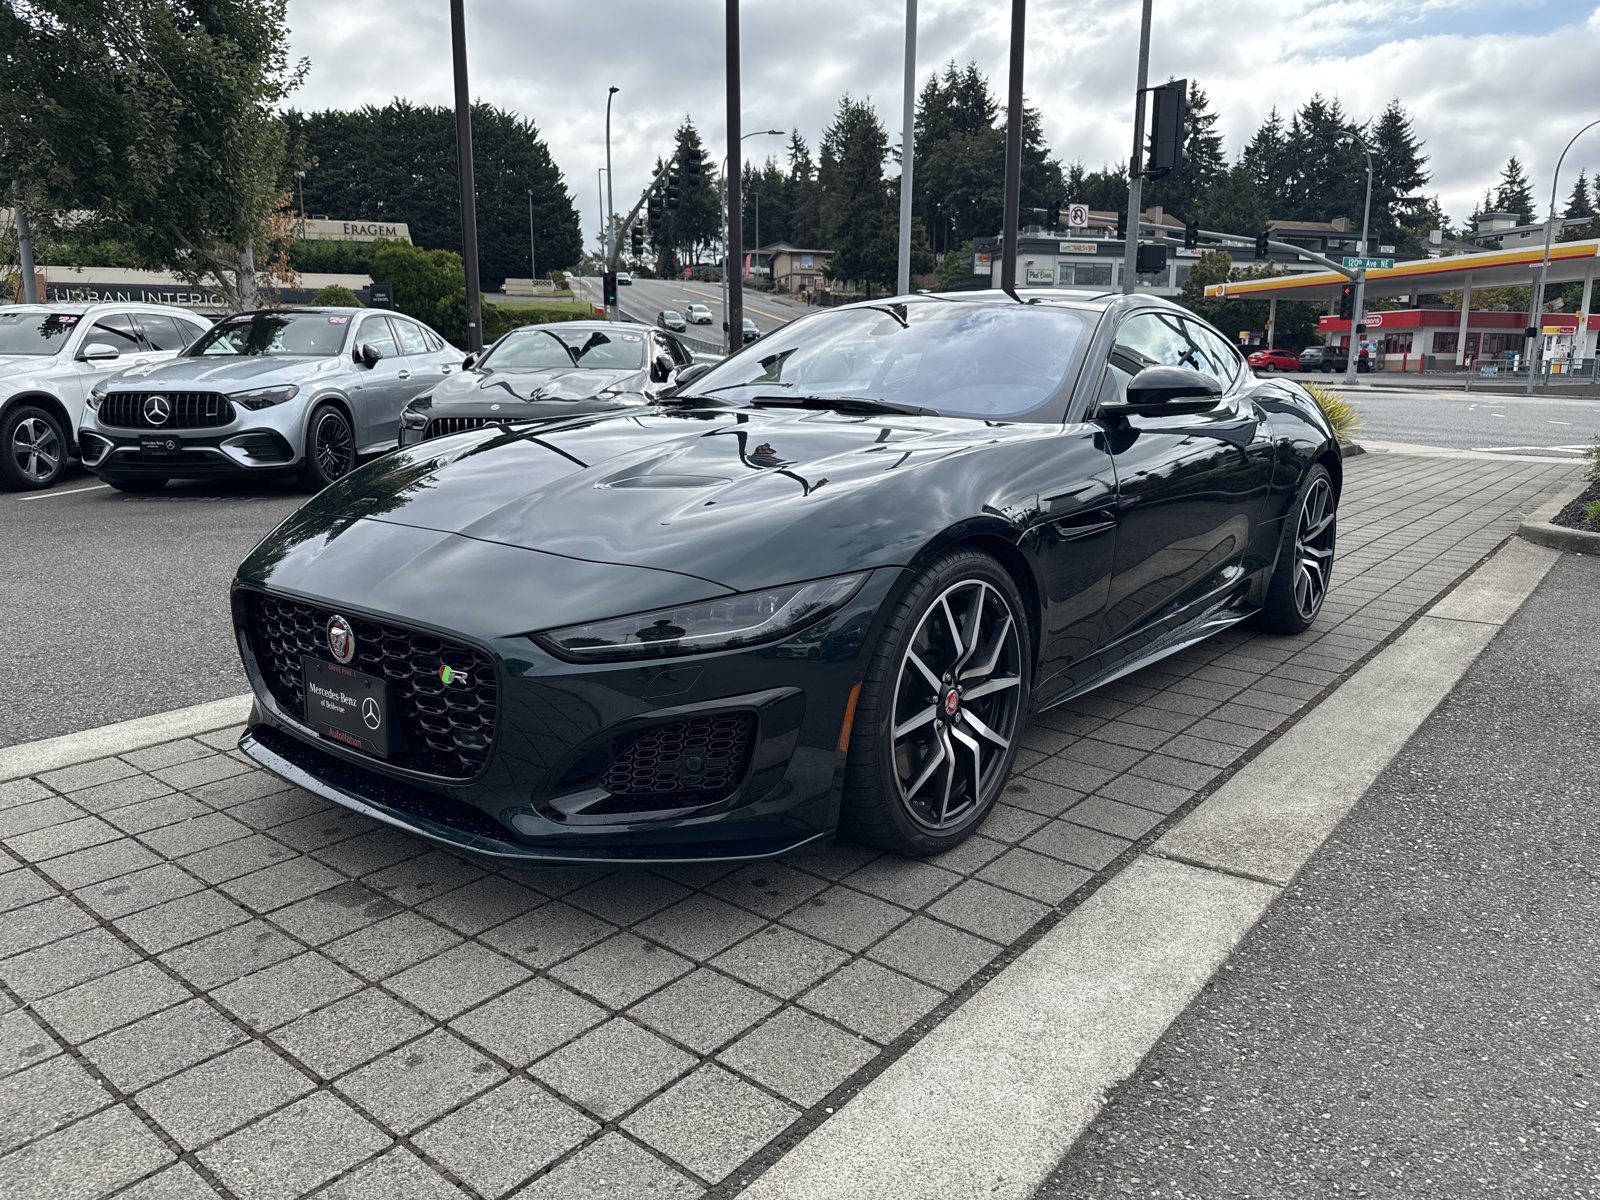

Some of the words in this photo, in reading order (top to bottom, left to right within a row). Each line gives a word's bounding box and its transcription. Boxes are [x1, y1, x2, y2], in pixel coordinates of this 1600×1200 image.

[1348, 258, 1363, 267] 120th
[1365, 259, 1378, 268] Ave
[1380, 260, 1389, 268] NE
[54, 288, 131, 304] URBAN
[141, 289, 230, 308] INTERIO
[309, 682, 358, 707] Mercedes-Benz
[325, 701, 346, 714] Bellevue
[328, 728, 363, 748] AutoNation
